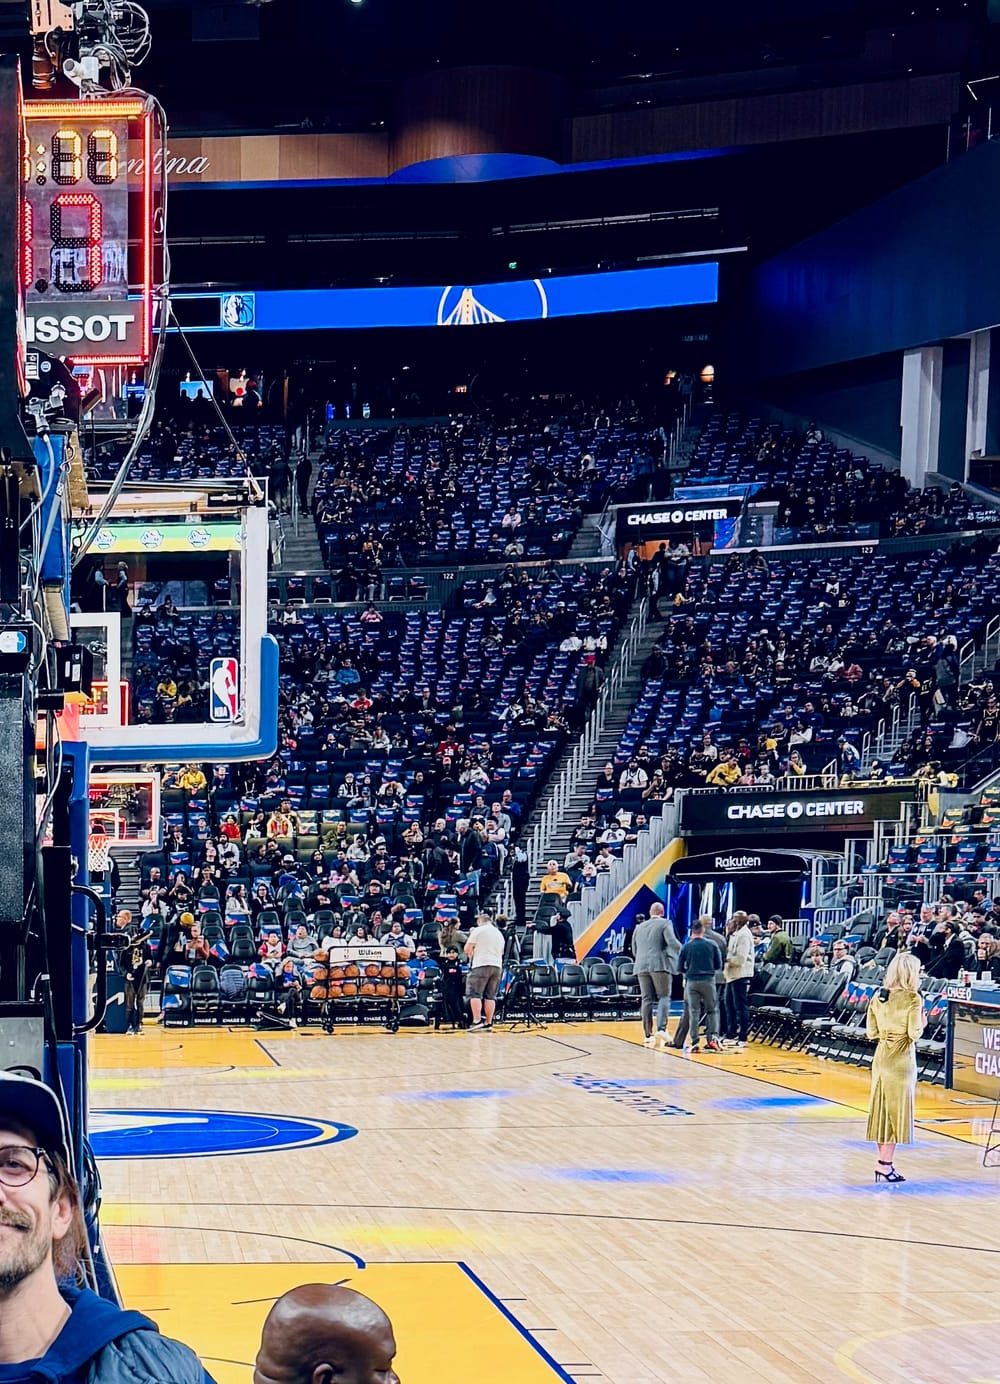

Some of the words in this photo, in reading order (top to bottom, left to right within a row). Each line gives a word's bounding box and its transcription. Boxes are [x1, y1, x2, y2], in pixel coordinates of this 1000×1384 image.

[25, 314, 135, 342] ISSOT
[627, 511, 671, 525] CHASE
[684, 508, 728, 522] CENTER
[861, 546, 874, 554] 123
[727, 804, 786, 819] CHASE
[805, 801, 865, 816] CENTER
[715, 856, 761, 870] Rakuten
[947, 985, 967, 1001] CHASE
